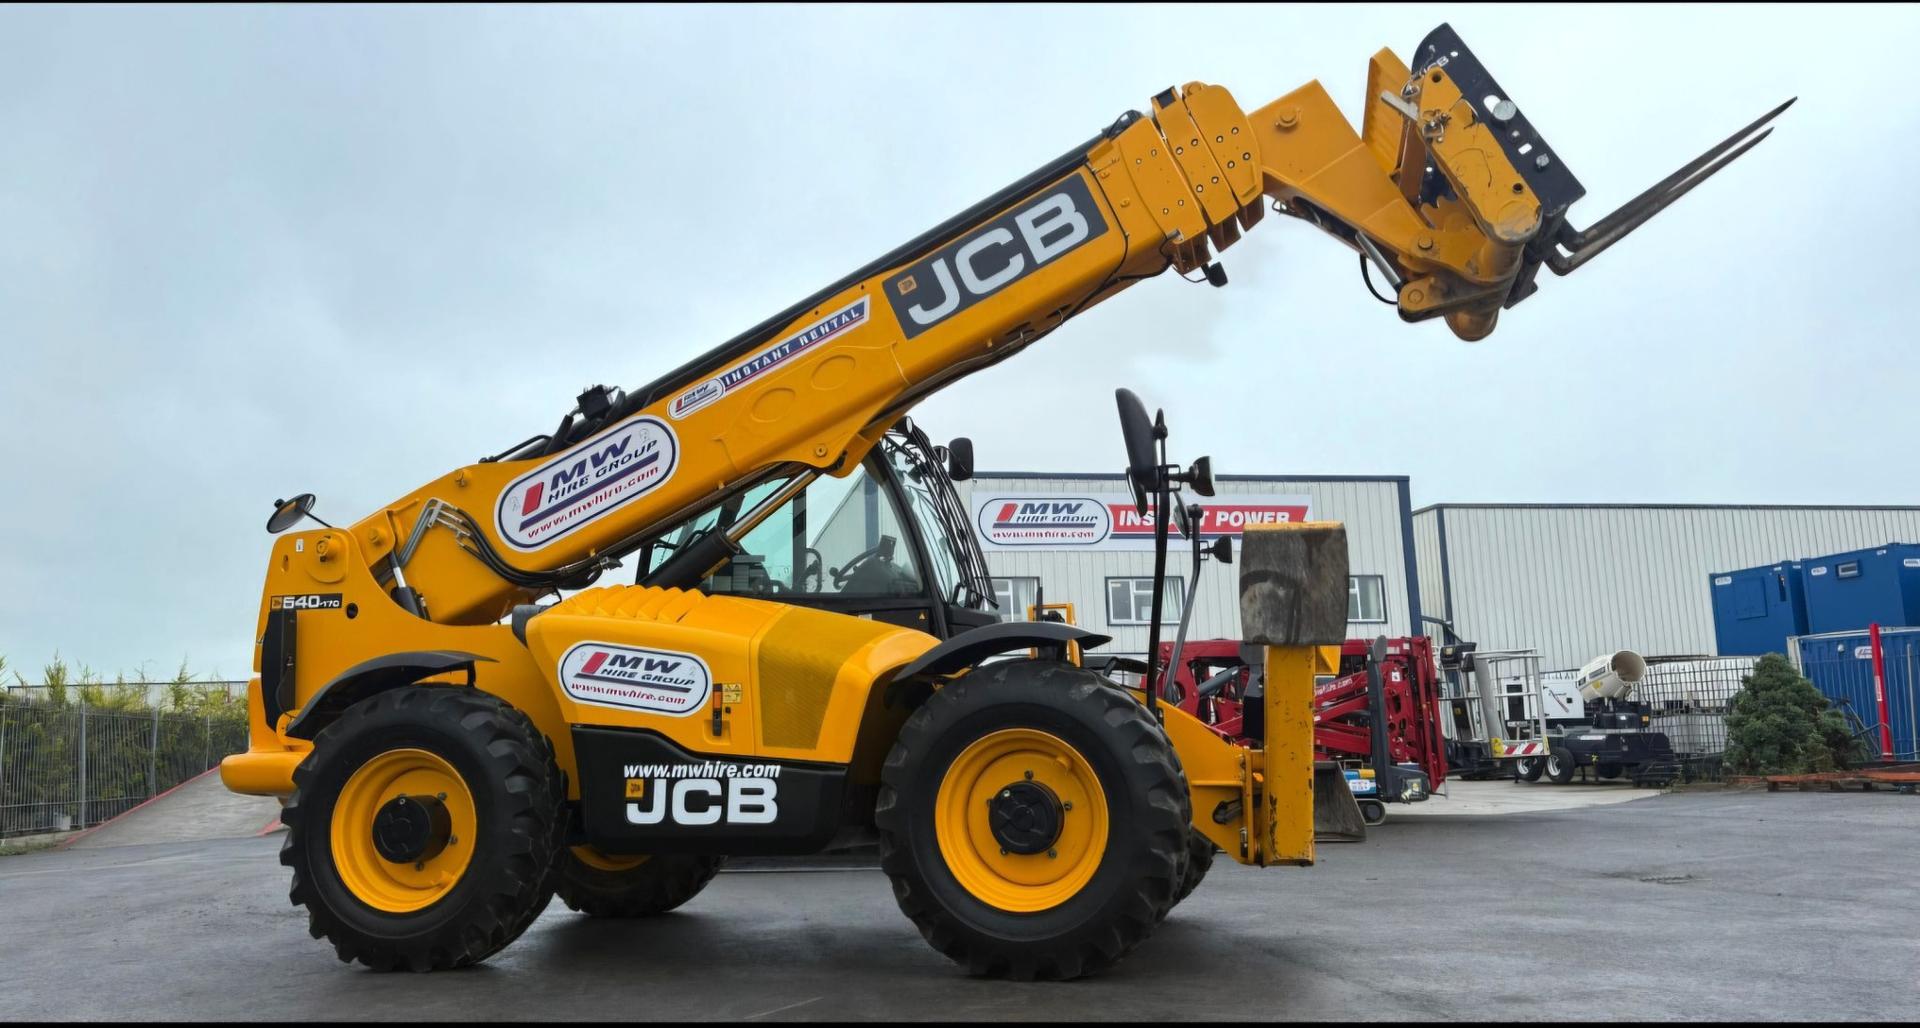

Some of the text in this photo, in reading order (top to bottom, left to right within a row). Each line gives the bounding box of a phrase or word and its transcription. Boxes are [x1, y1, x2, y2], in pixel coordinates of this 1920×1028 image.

[908, 193, 1089, 325] JCB
[725, 308, 860, 386] INSTANT RENTAL
[548, 440, 658, 503] HIRE GROUP
[550, 434, 632, 491] MW
[528, 466, 659, 539] www.mwhire.com
[1019, 503, 1084, 515] MW
[1216, 511, 1290, 527] POWER
[600, 668, 695, 686] HIRE GROUP
[608, 654, 682, 674] MW
[571, 682, 687, 705] www.mwhire.com
[623, 761, 781, 778] www.mwhire.com
[626, 777, 778, 825] JCB
